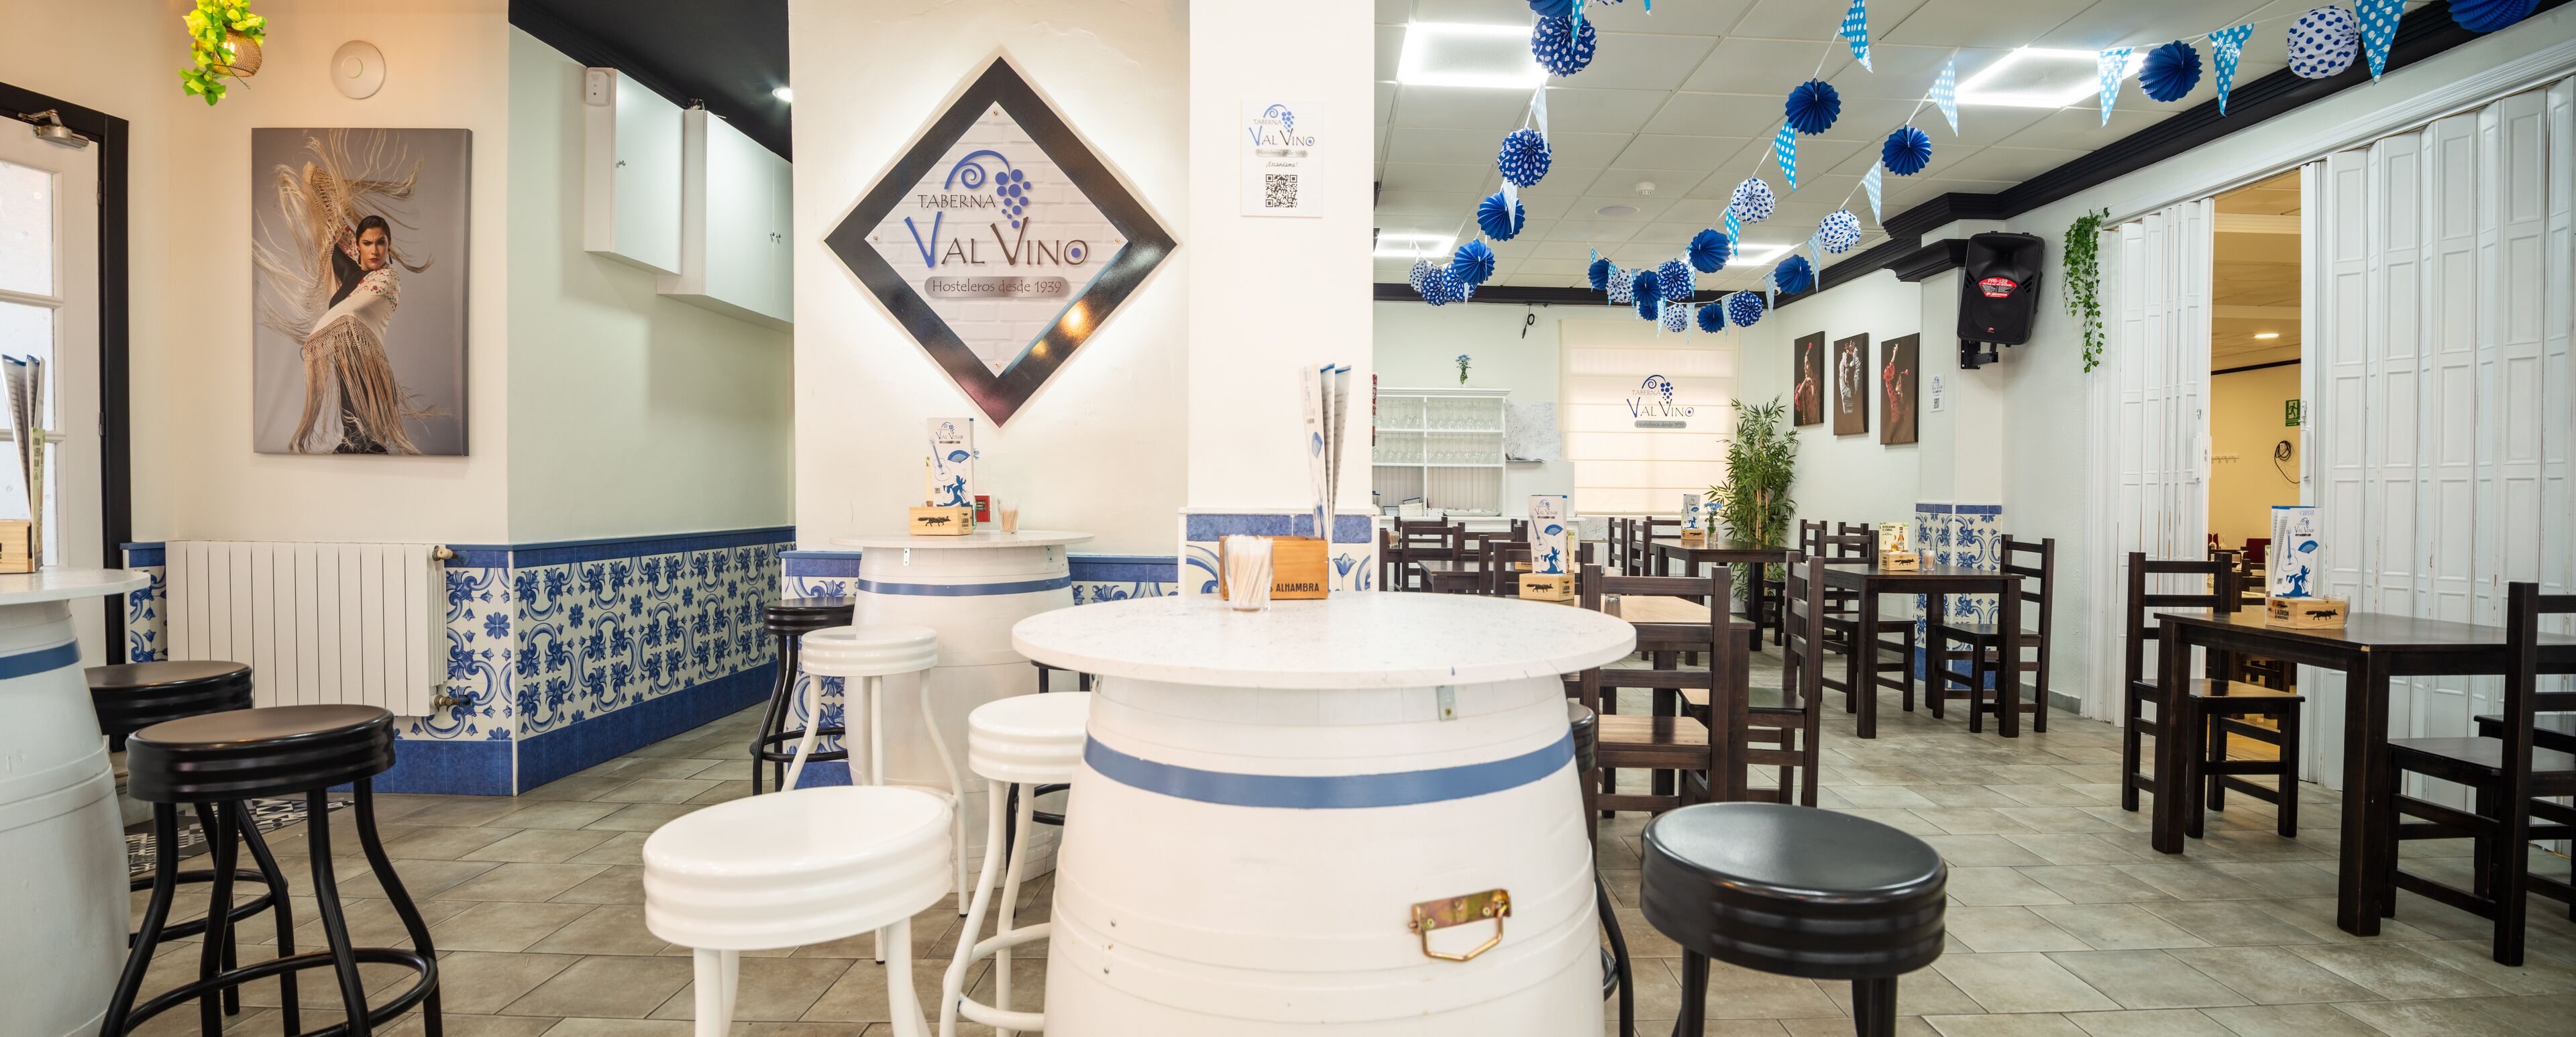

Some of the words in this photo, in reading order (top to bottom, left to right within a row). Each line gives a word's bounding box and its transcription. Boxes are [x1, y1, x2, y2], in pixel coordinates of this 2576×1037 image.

[1248, 125, 1278, 146] VAL
[1279, 127, 1315, 146] VINO
[918, 195, 996, 209] TABERNA
[904, 211, 985, 268] VAL
[990, 217, 1088, 266] VINO
[932, 280, 995, 293] Hosteleros
[998, 280, 1031, 293] desde
[1034, 281, 1062, 294] 1939
[1626, 397, 1657, 418] VAL
[1658, 398, 1695, 417] VINO
[1276, 583, 1320, 592] ALHAMBRA
